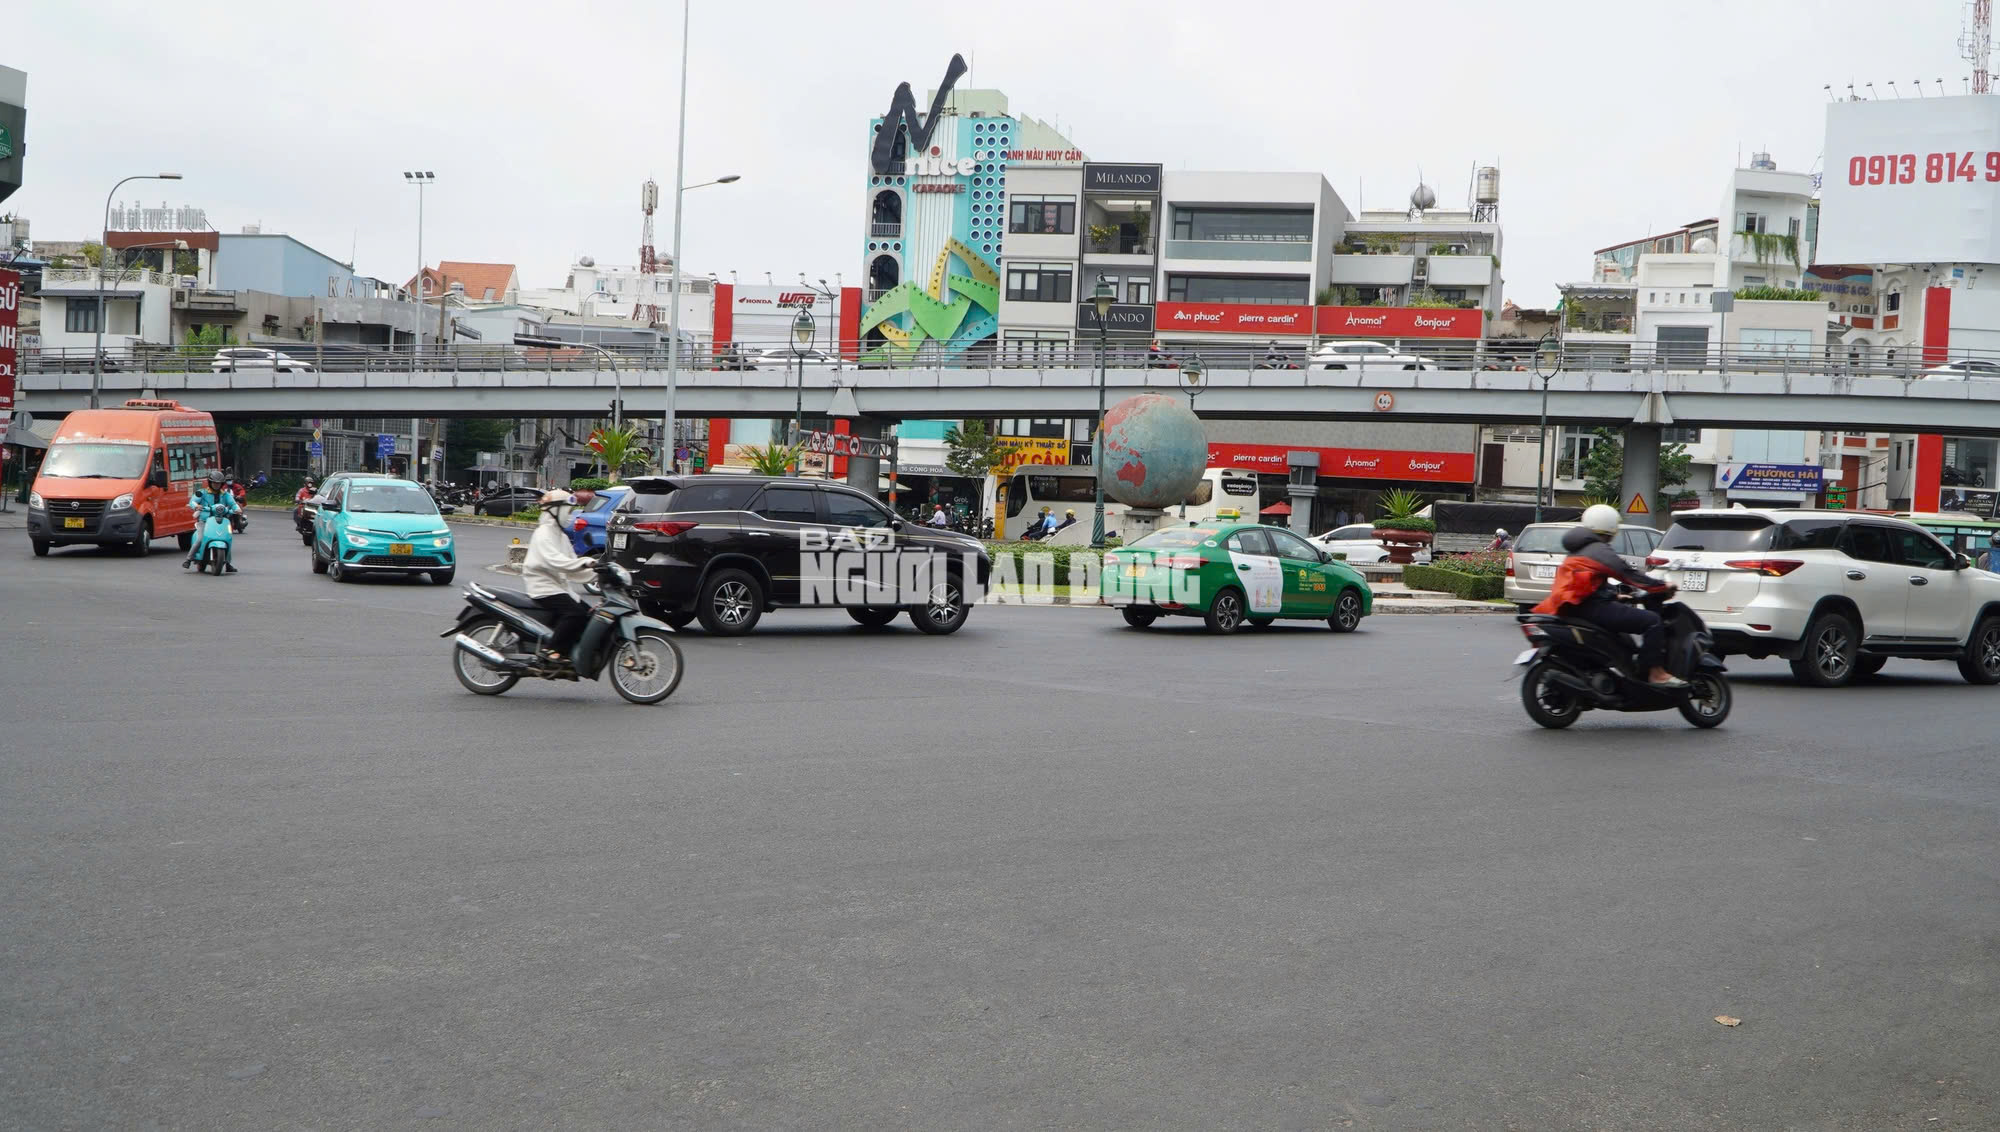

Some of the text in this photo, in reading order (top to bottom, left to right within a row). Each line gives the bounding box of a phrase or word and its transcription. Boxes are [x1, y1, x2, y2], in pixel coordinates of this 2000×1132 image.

[1026, 147, 1043, 161] MÀU
[1046, 150, 1063, 161] HUY
[905, 146, 977, 176] nice
[1849, 153, 1916, 186] 0913
[1925, 151, 1977, 183] 814
[912, 183, 967, 193] KARAOKE
[1194, 311, 1221, 321] phuoc
[1238, 314, 1295, 323] pierre cardin
[1345, 312, 1382, 326] Anamai
[1414, 315, 1451, 330] Bonjour
[1233, 454, 1282, 463] pierre cardin
[1344, 456, 1376, 467] Anamai
[1408, 459, 1441, 472] Bonjour
[1746, 468, 1795, 478] PHƯƠNG
